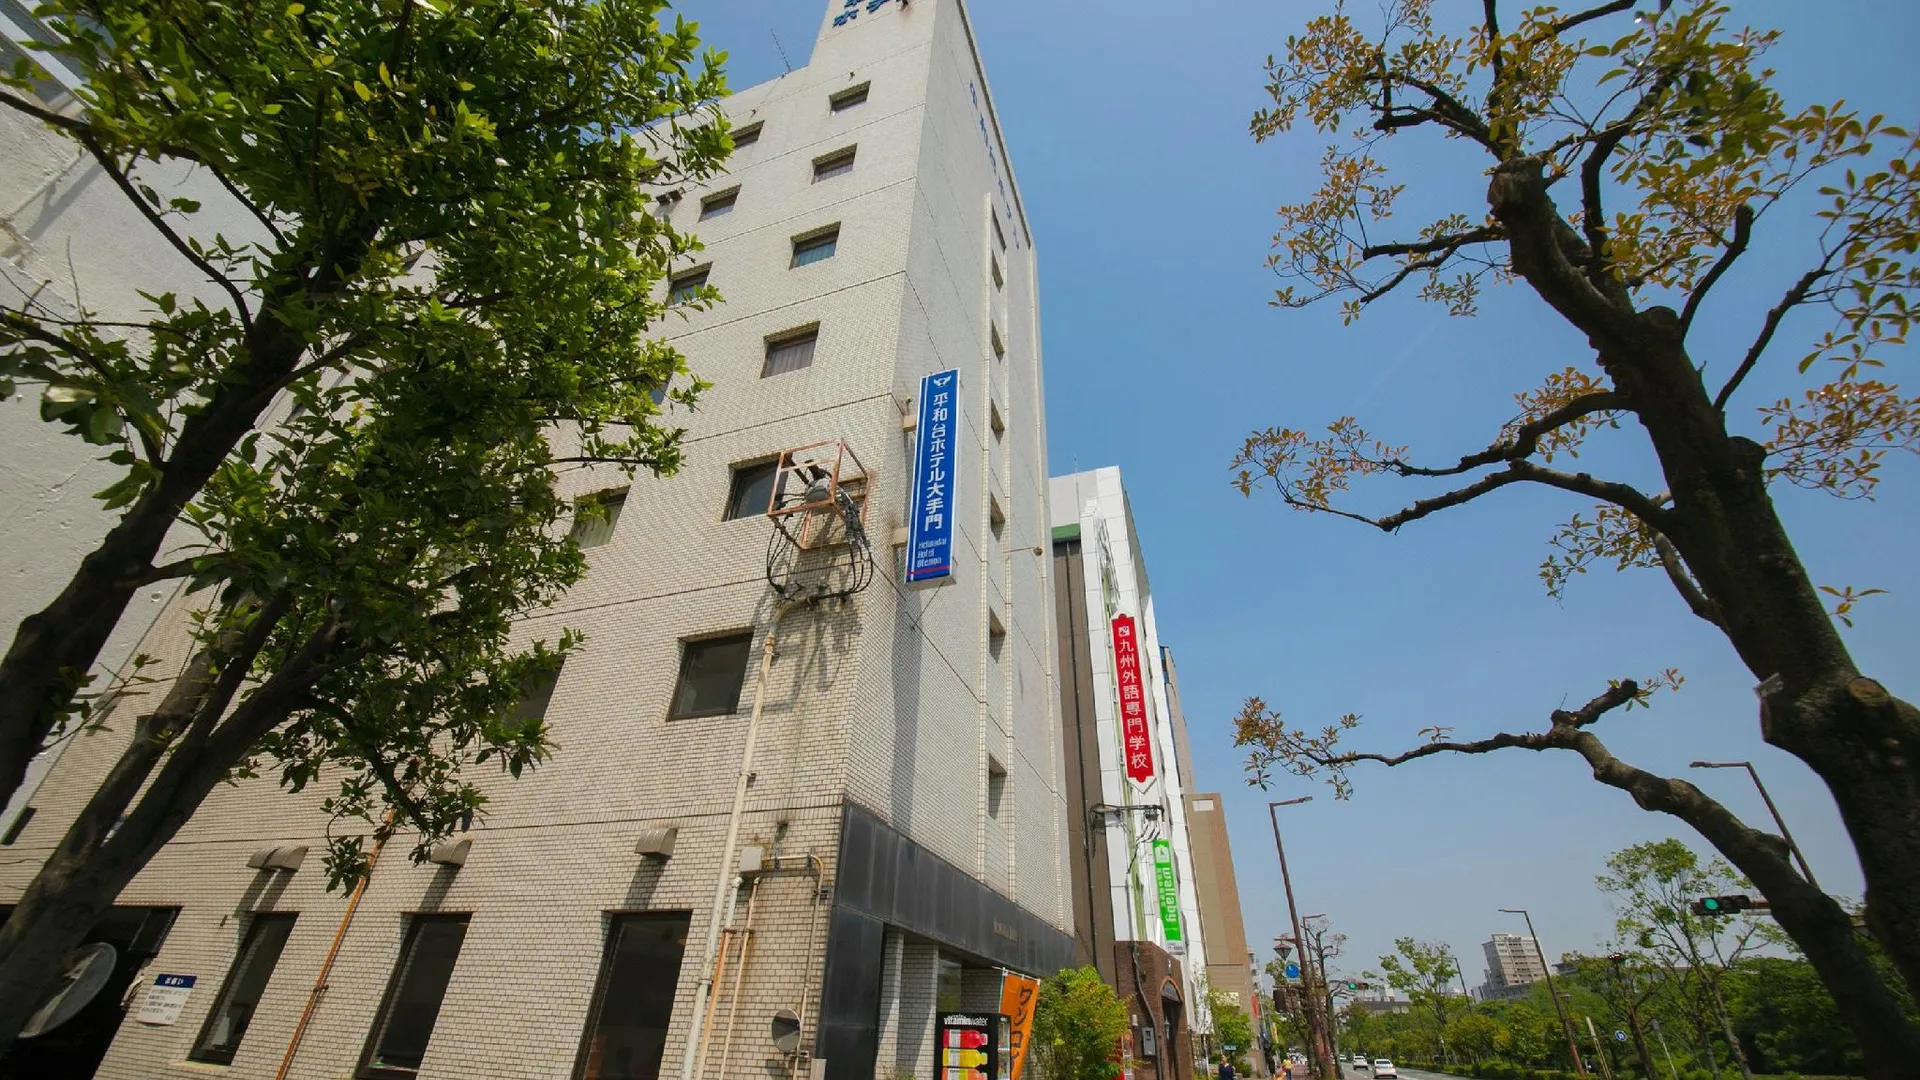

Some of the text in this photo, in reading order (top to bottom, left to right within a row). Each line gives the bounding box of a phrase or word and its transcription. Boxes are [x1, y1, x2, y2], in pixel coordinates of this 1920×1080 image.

[925, 392, 949, 532] 平和台ホテル大手門
[1118, 638, 1149, 769] 九州外語専門学校
[1162, 867, 1178, 922] wallaby
